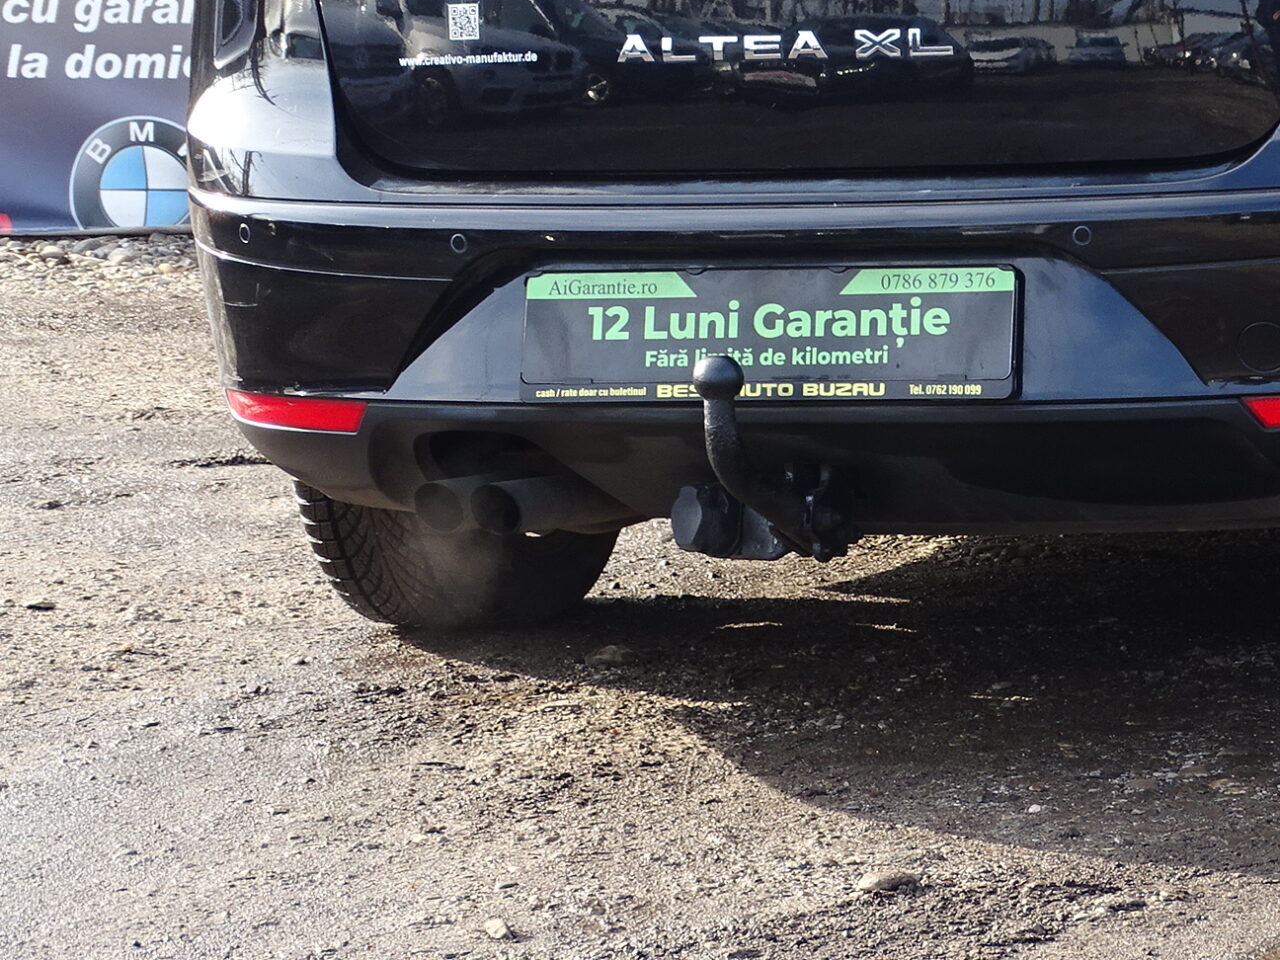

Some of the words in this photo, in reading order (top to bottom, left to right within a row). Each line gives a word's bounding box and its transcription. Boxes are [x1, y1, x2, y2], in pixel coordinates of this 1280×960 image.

[617, 30, 829, 63] ALTEA
[854, 27, 954, 58] XL
[7, 44, 48, 79] la
[548, 279, 658, 297] AiGarantie.ro
[881, 272, 922, 290] 0786
[928, 271, 959, 289] 879
[964, 270, 996, 288] 376
[588, 305, 630, 341] 12
[644, 300, 740, 340] Luni
[753, 296, 951, 348] Garanție
[646, 349, 689, 368] Fără
[759, 348, 786, 366] de
[792, 345, 889, 366] kilometri
[535, 387, 555, 398] cash
[561, 387, 579, 398] rate
[579, 387, 598, 398] doar
[598, 388, 609, 397] cu
[656, 383, 703, 398] BES
[803, 382, 886, 397] BUZAU
[909, 383, 925, 395] Tel.
[925, 384, 948, 395] 0762
[948, 384, 964, 395] 190
[964, 384, 982, 395] 099
